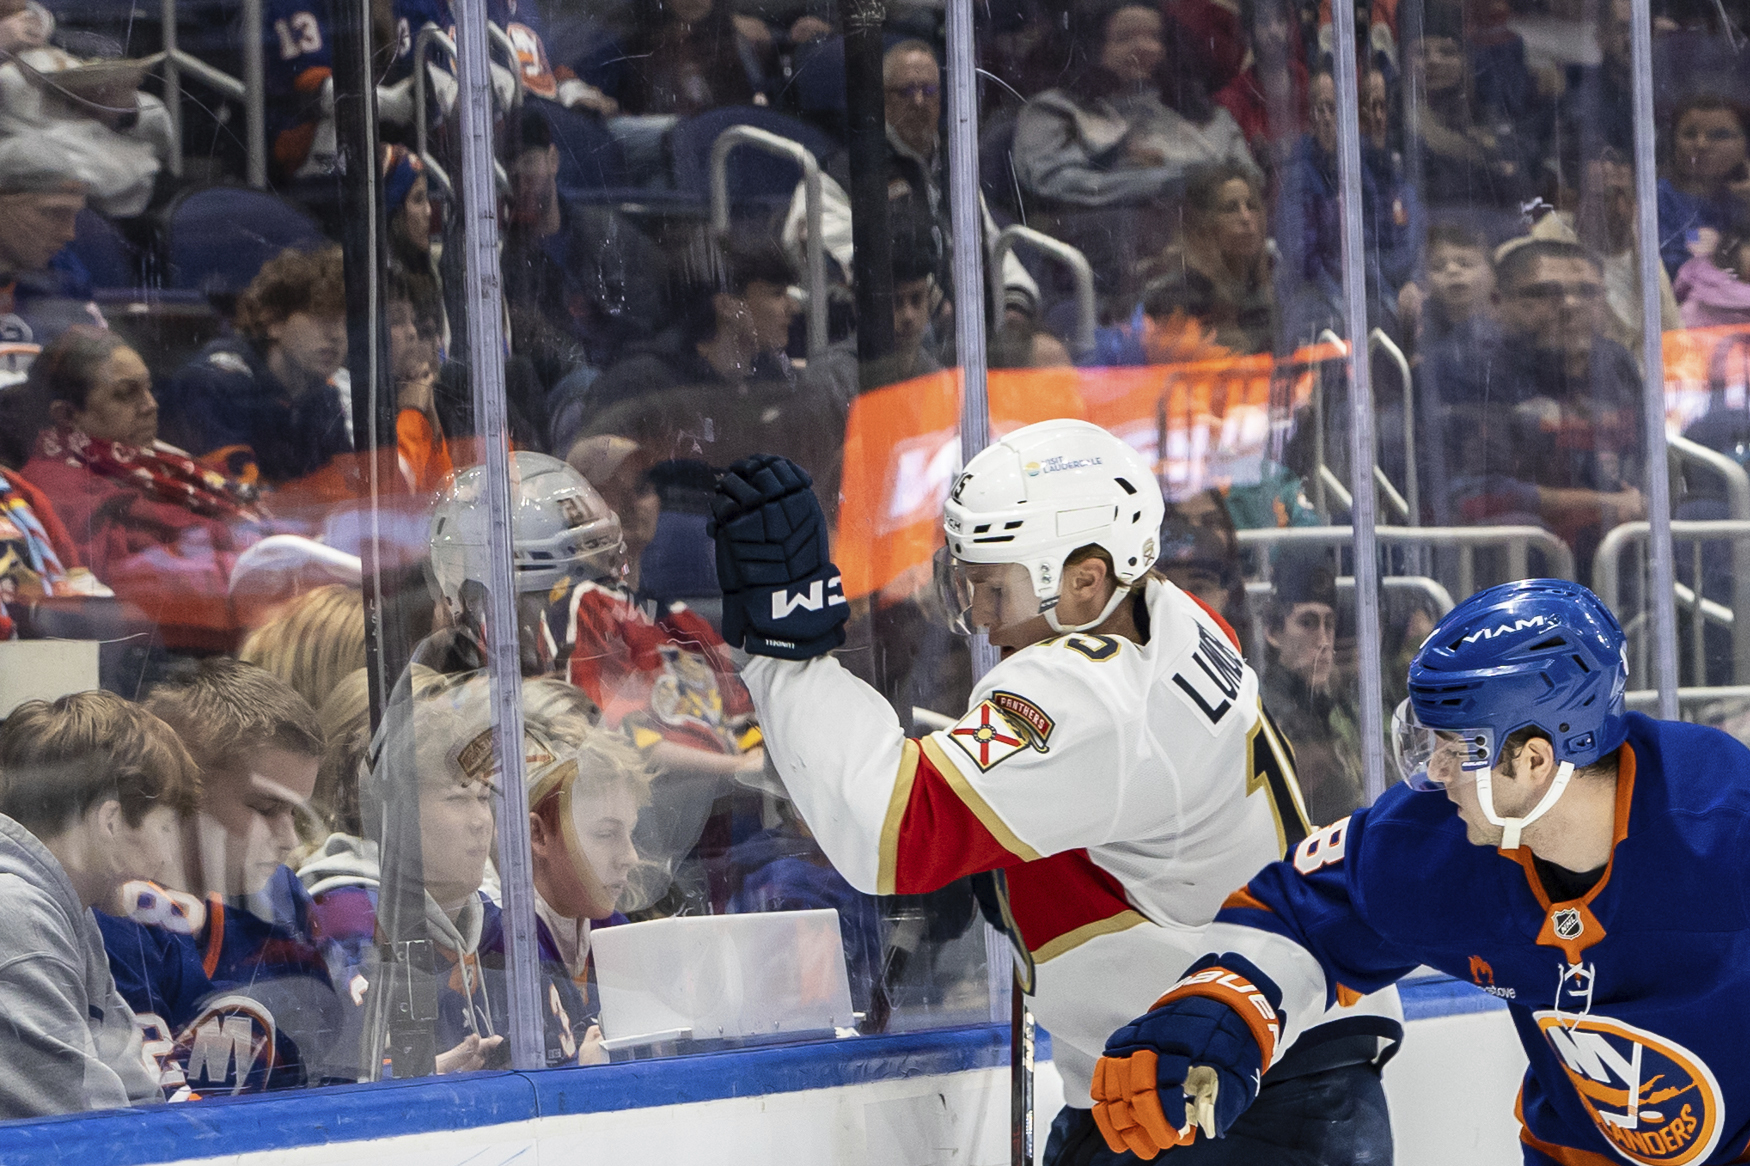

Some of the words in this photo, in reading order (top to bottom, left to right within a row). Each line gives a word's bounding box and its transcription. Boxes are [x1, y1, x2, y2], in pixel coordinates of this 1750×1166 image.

[274, 11, 322, 60] 13
[1462, 615, 1544, 643] VIAM
[1000, 697, 1045, 730] PANTHERS
[1294, 815, 1352, 875] 8
[1560, 915, 1577, 934] NHL
